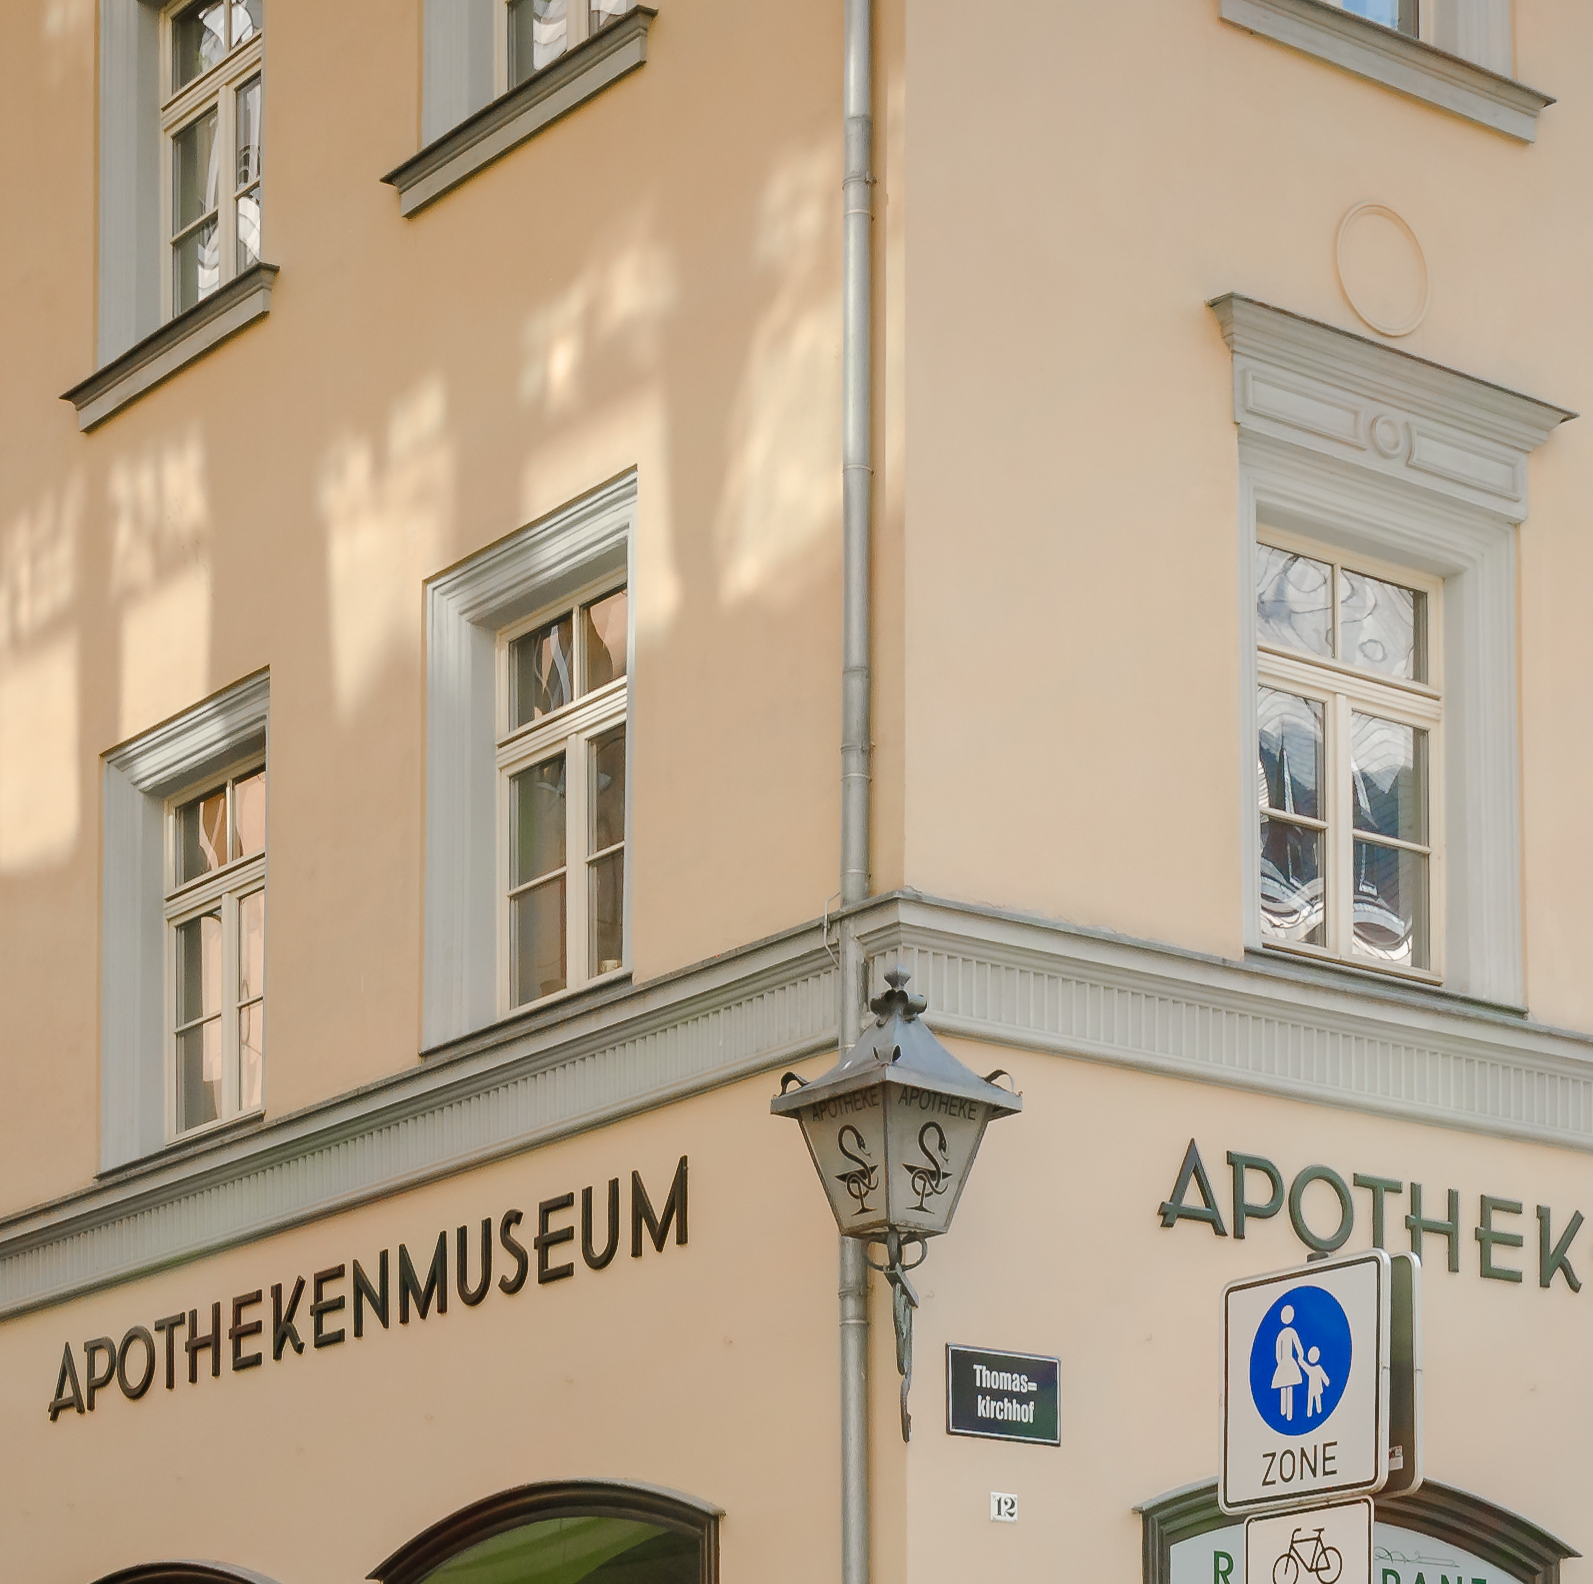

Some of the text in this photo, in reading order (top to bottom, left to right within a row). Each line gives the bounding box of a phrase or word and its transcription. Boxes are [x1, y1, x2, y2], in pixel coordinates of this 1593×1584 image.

[48, 1155, 688, 1422] APOTHEKENMUSEUM
[977, 1395, 1035, 1423] kirchhof
[1261, 1441, 1338, 1487] ZONE
[994, 1496, 1016, 1518] 12
